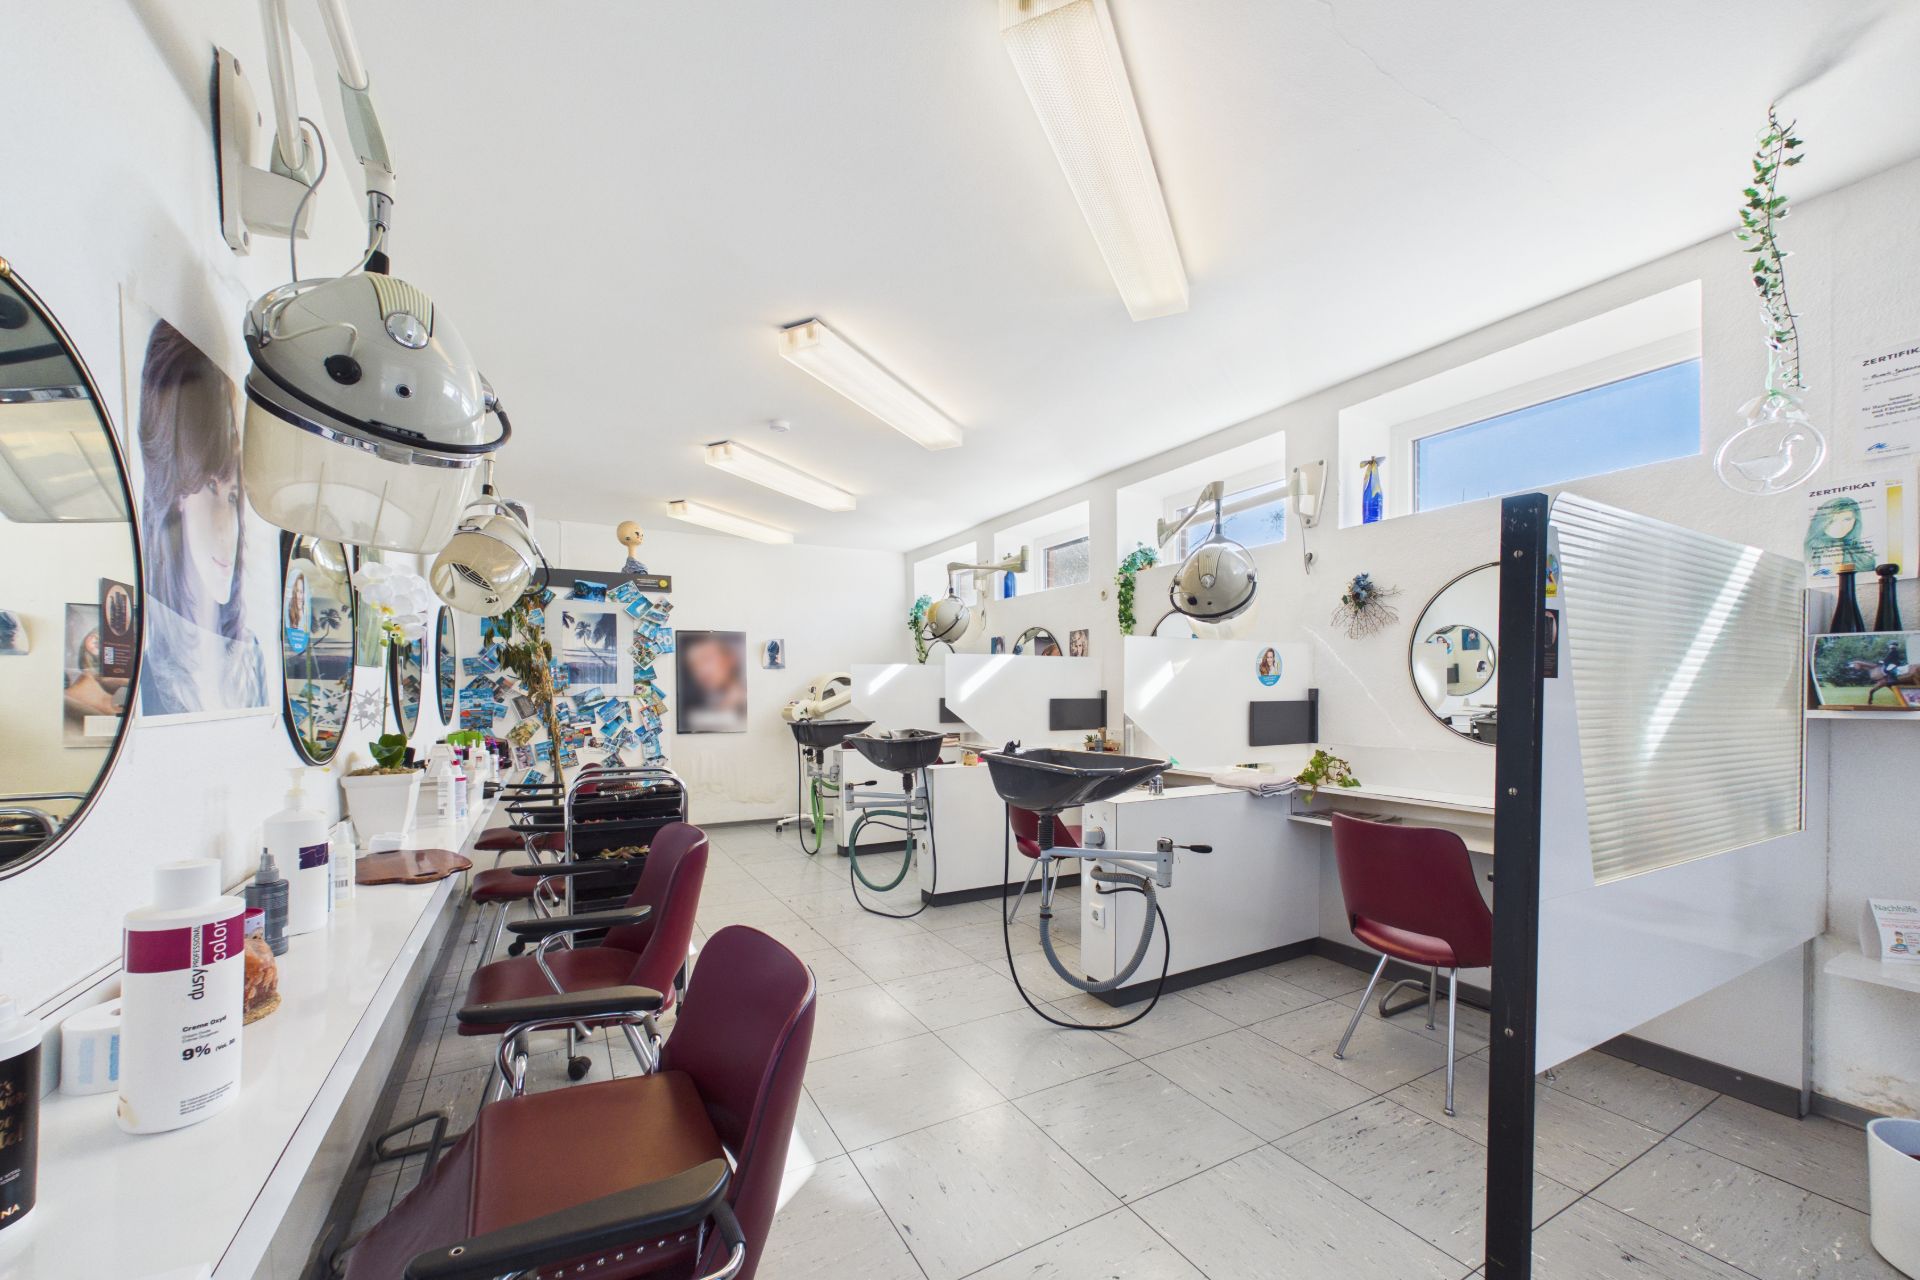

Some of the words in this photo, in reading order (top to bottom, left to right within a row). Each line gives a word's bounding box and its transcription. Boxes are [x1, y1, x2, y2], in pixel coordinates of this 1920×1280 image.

[1808, 481, 1877, 498] ZERTIFIKAT
[192, 924, 201, 968] PROFESSIONAL
[208, 921, 227, 963] color
[187, 968, 208, 1000] dusy
[182, 1022, 209, 1032] Creme
[182, 1043, 211, 1061] 9%
